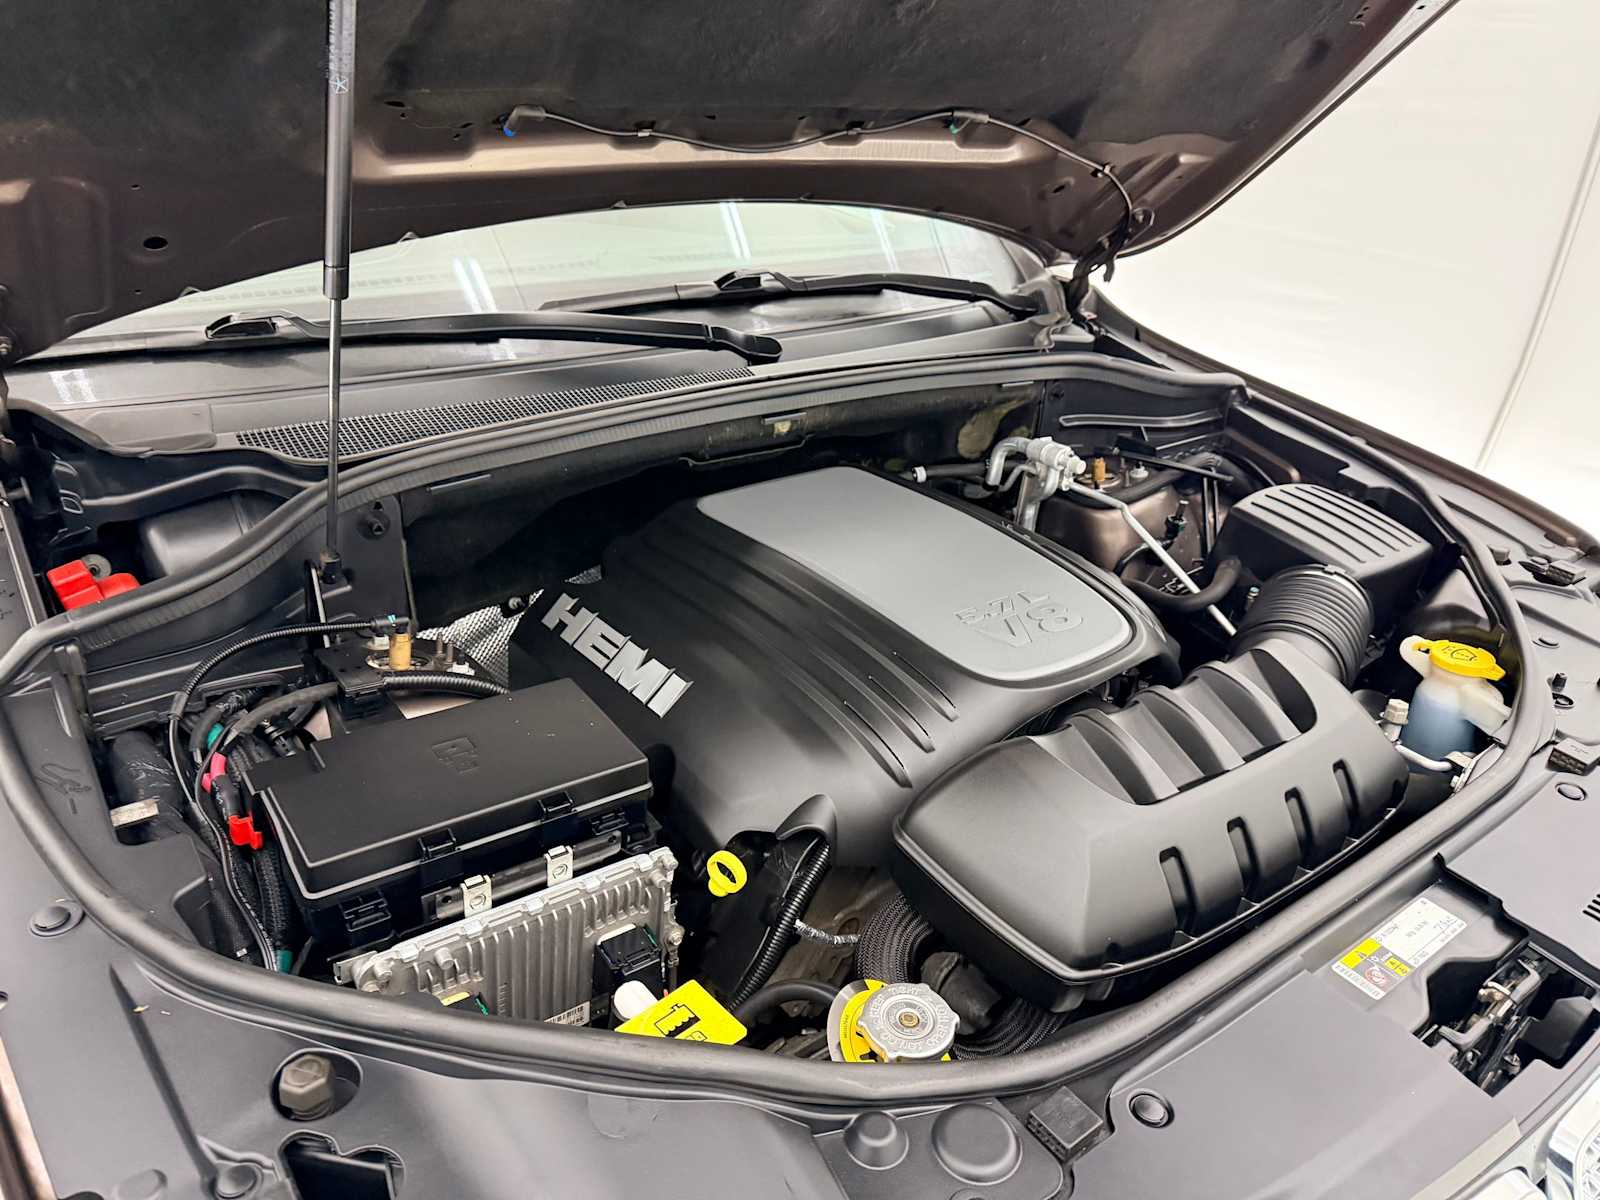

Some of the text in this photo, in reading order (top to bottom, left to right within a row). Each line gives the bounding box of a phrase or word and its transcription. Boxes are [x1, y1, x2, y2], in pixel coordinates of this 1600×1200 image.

[955, 591, 1050, 625] 5.7L
[967, 601, 1084, 649] V8
[541, 593, 694, 718] HEMI
